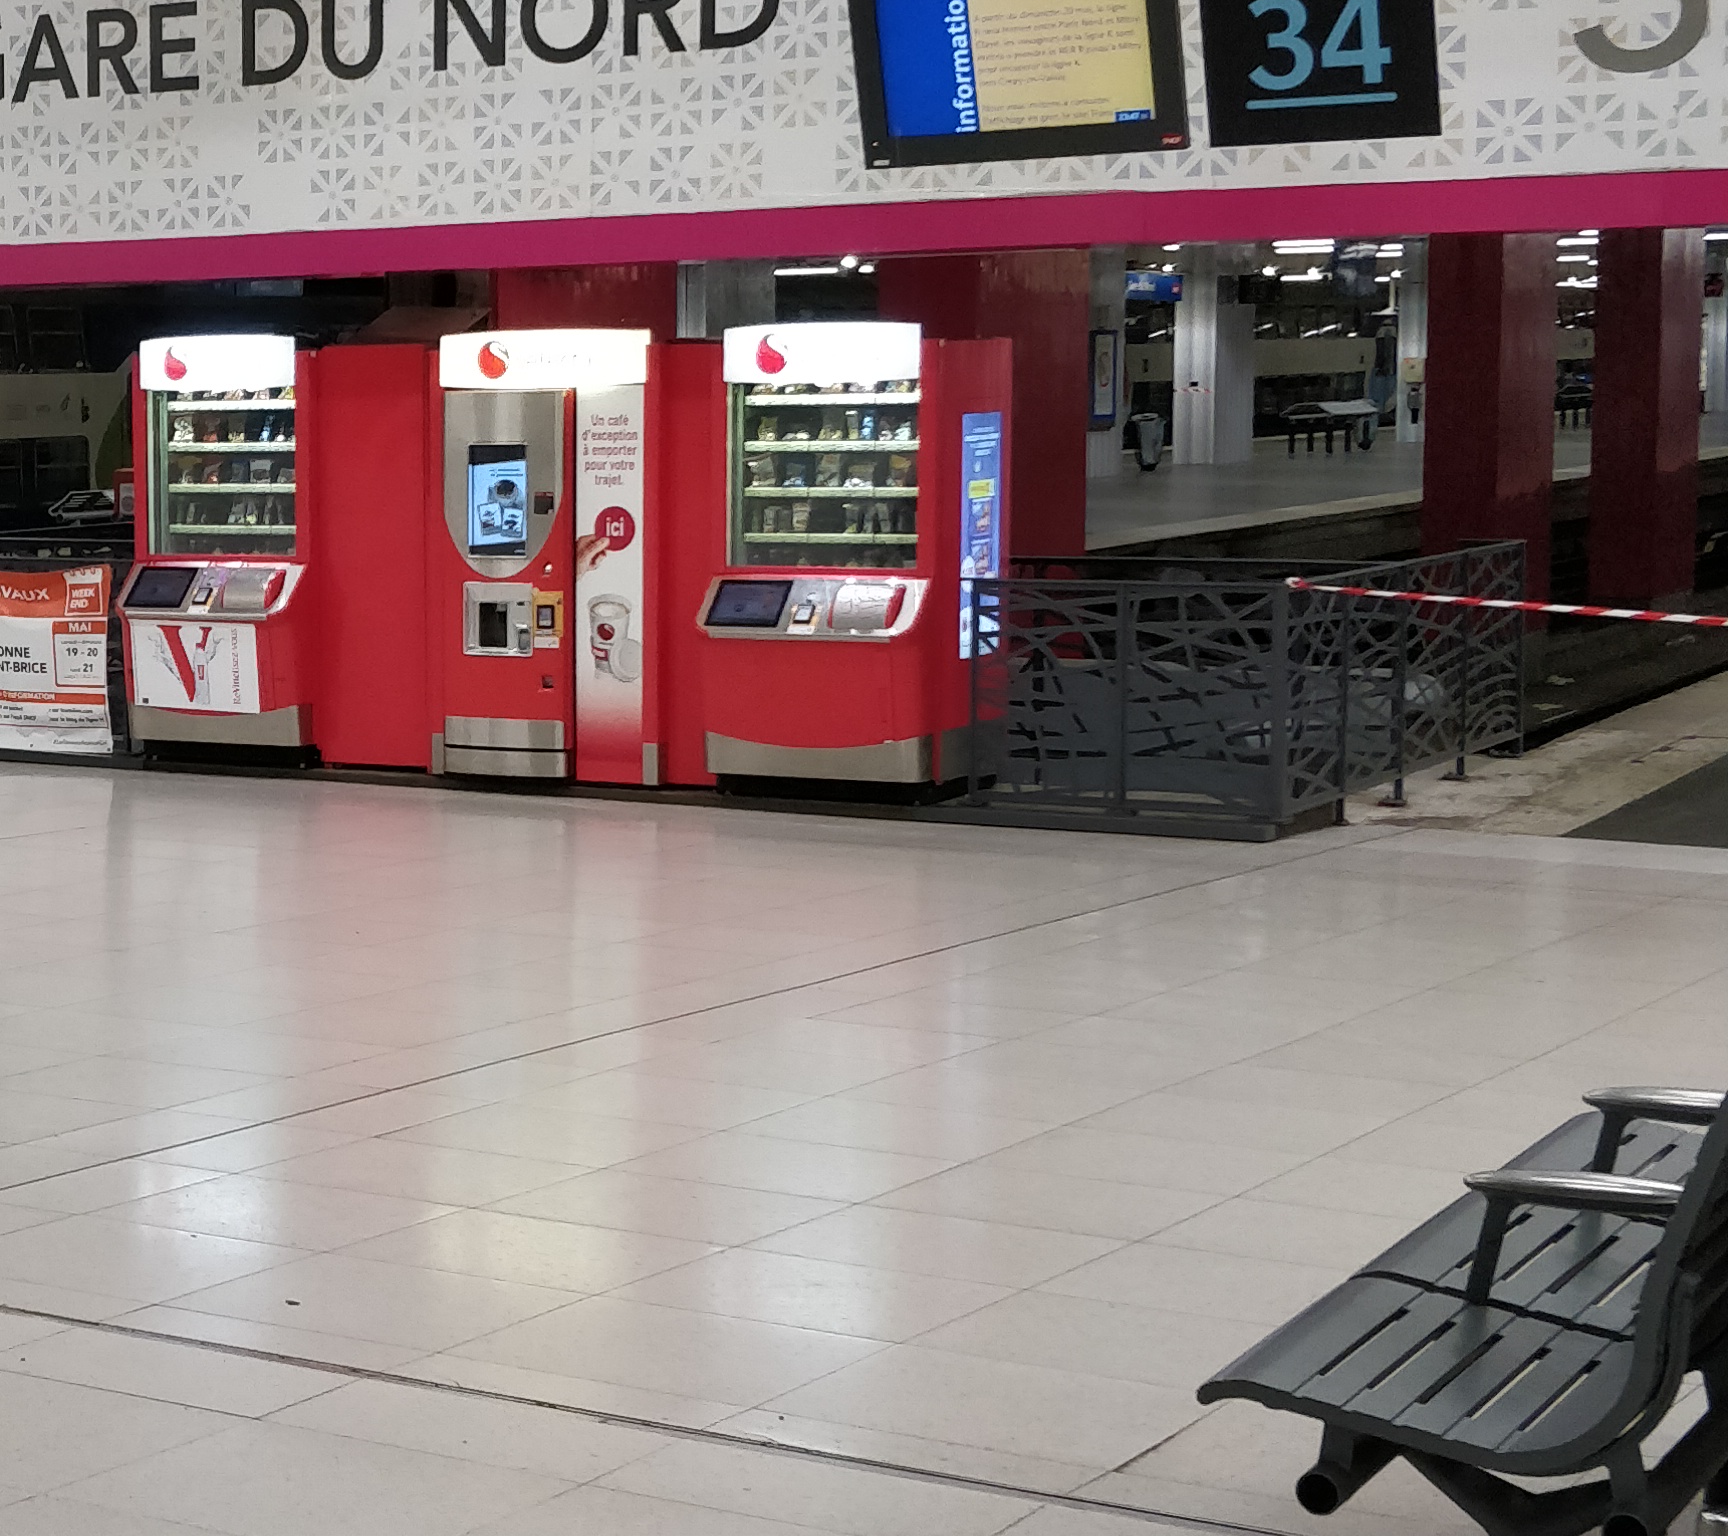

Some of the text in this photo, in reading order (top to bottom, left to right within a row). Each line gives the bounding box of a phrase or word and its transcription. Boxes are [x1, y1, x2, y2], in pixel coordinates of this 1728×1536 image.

[590, 413, 629, 427] Un café
[582, 443, 638, 459] à emporter
[584, 460, 635, 472] pour votre
[605, 516, 625, 537] ici
[68, 621, 92, 633] MAI
[65, 647, 78, 657] 19
[86, 647, 99, 657] 20
[82, 662, 94, 673] 21
